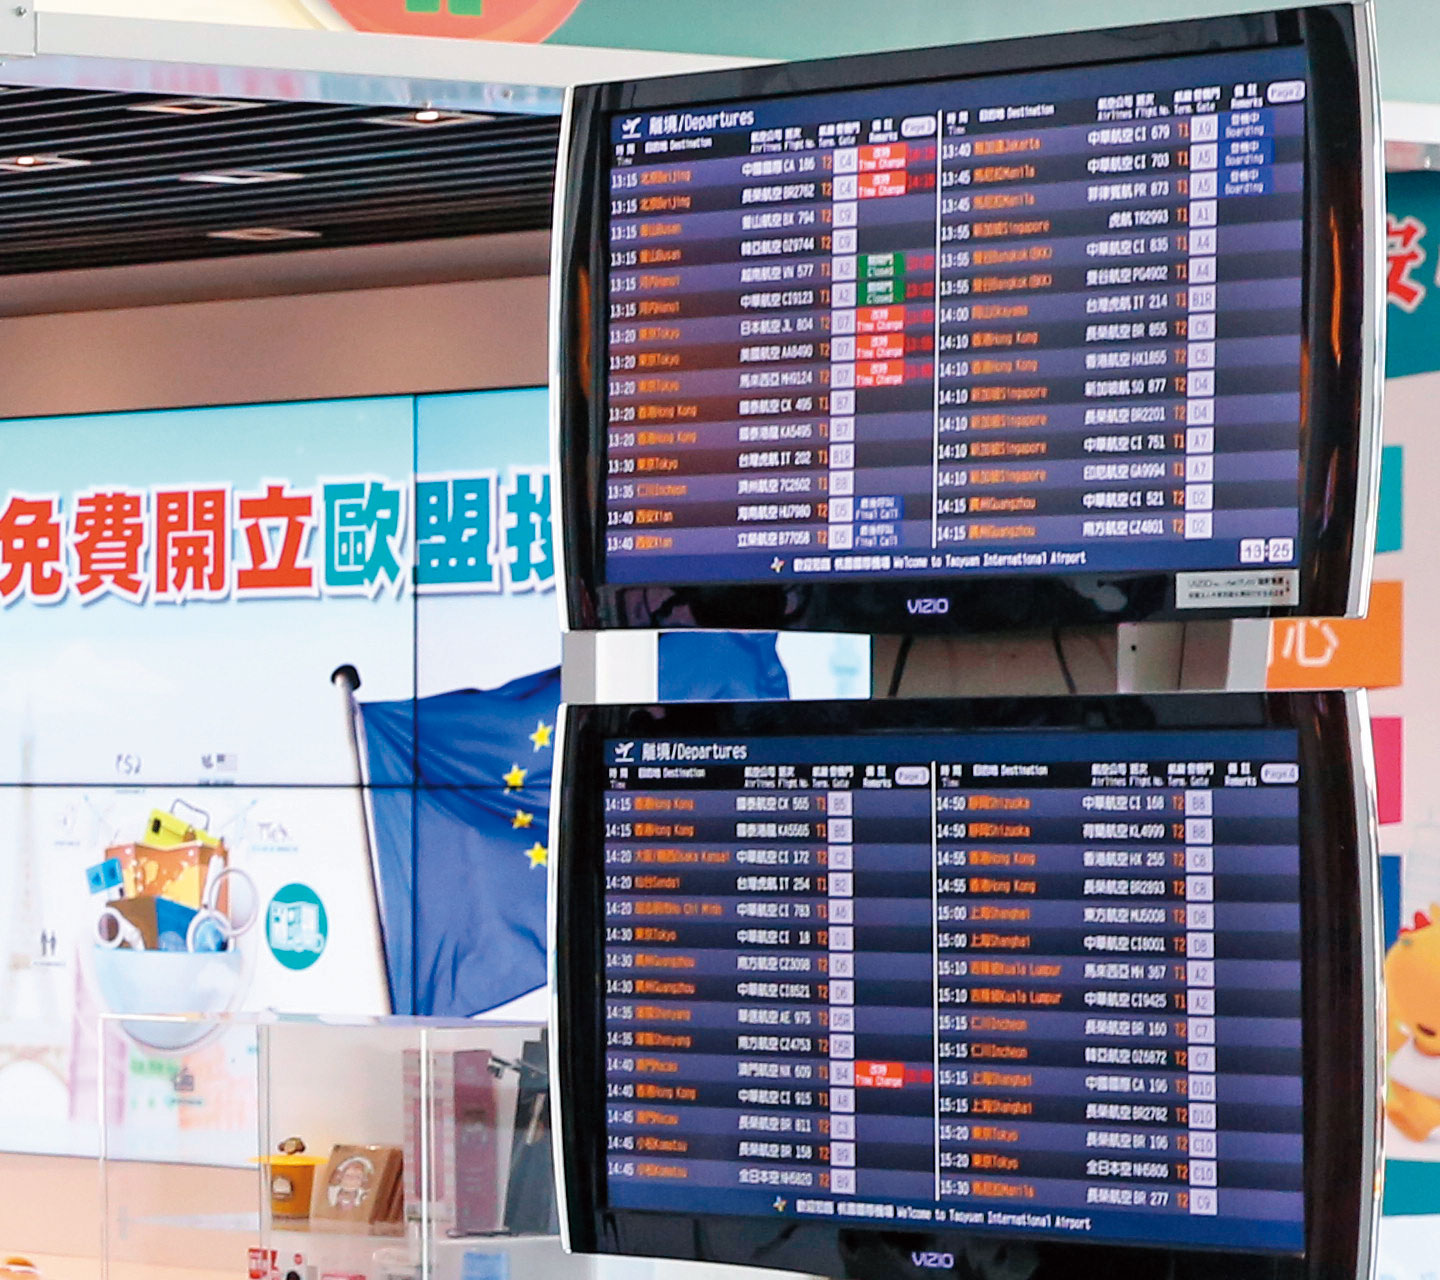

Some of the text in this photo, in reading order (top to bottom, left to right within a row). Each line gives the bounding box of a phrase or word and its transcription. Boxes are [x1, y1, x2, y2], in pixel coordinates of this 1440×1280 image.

[941, 143, 971, 159] 13:40
[612, 173, 637, 188] 13:15
[943, 170, 970, 186] 13:45
[612, 225, 636, 240] 13:15
[942, 225, 969, 240] 13:55
[942, 252, 969, 268] 13:55
[611, 304, 635, 318] 13:15
[941, 307, 969, 322] 14:00
[611, 330, 635, 343] 13:20
[938, 335, 968, 349] 14:10
[940, 389, 967, 404] 14:10
[610, 408, 634, 421] 13:20
[937, 444, 967, 459] 14:10
[609, 460, 634, 473] 13:30
[609, 485, 633, 499] 13:35
[936, 498, 966, 513] 14:15
[608, 511, 633, 525] 13:40
[936, 525, 966, 541] 14:15
[608, 537, 633, 551] 13:40
[907, 599, 949, 614] VIZIO
[606, 798, 630, 811] 14:15
[935, 797, 965, 810] 14:50
[607, 850, 631, 863] 14:20
[938, 852, 965, 865] 14:55
[607, 902, 631, 914] 14:20
[936, 906, 966, 920] 15:00
[607, 928, 632, 940] 14:30
[939, 961, 967, 975] 15:10
[937, 988, 967, 1002] 15:10
[608, 1006, 632, 1018] 14:35
[937, 1016, 967, 1030] 15:15
[608, 1058, 633, 1071] 14:40
[940, 1071, 967, 1085] 15:15
[609, 1111, 633, 1123] 14:45
[938, 1125, 968, 1140] 15:20
[609, 1162, 633, 1176] 14:45
[941, 1180, 969, 1194] 15:30
[911, 1251, 954, 1268] VIZIO
